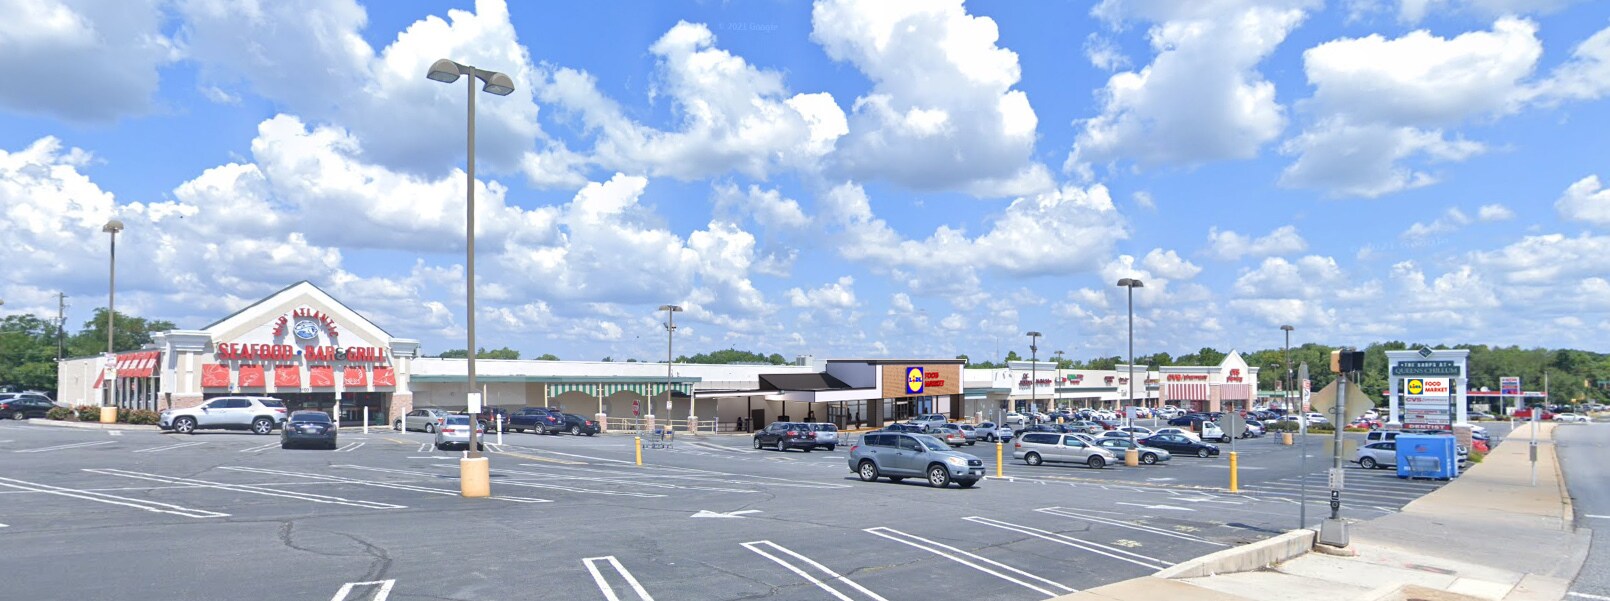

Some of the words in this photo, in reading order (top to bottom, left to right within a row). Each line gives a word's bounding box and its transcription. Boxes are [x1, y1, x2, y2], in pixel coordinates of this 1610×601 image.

[293, 307, 339, 337] ATLANTIC
[219, 343, 294, 361] SEAFOOD
[346, 346, 386, 362] GRILL
